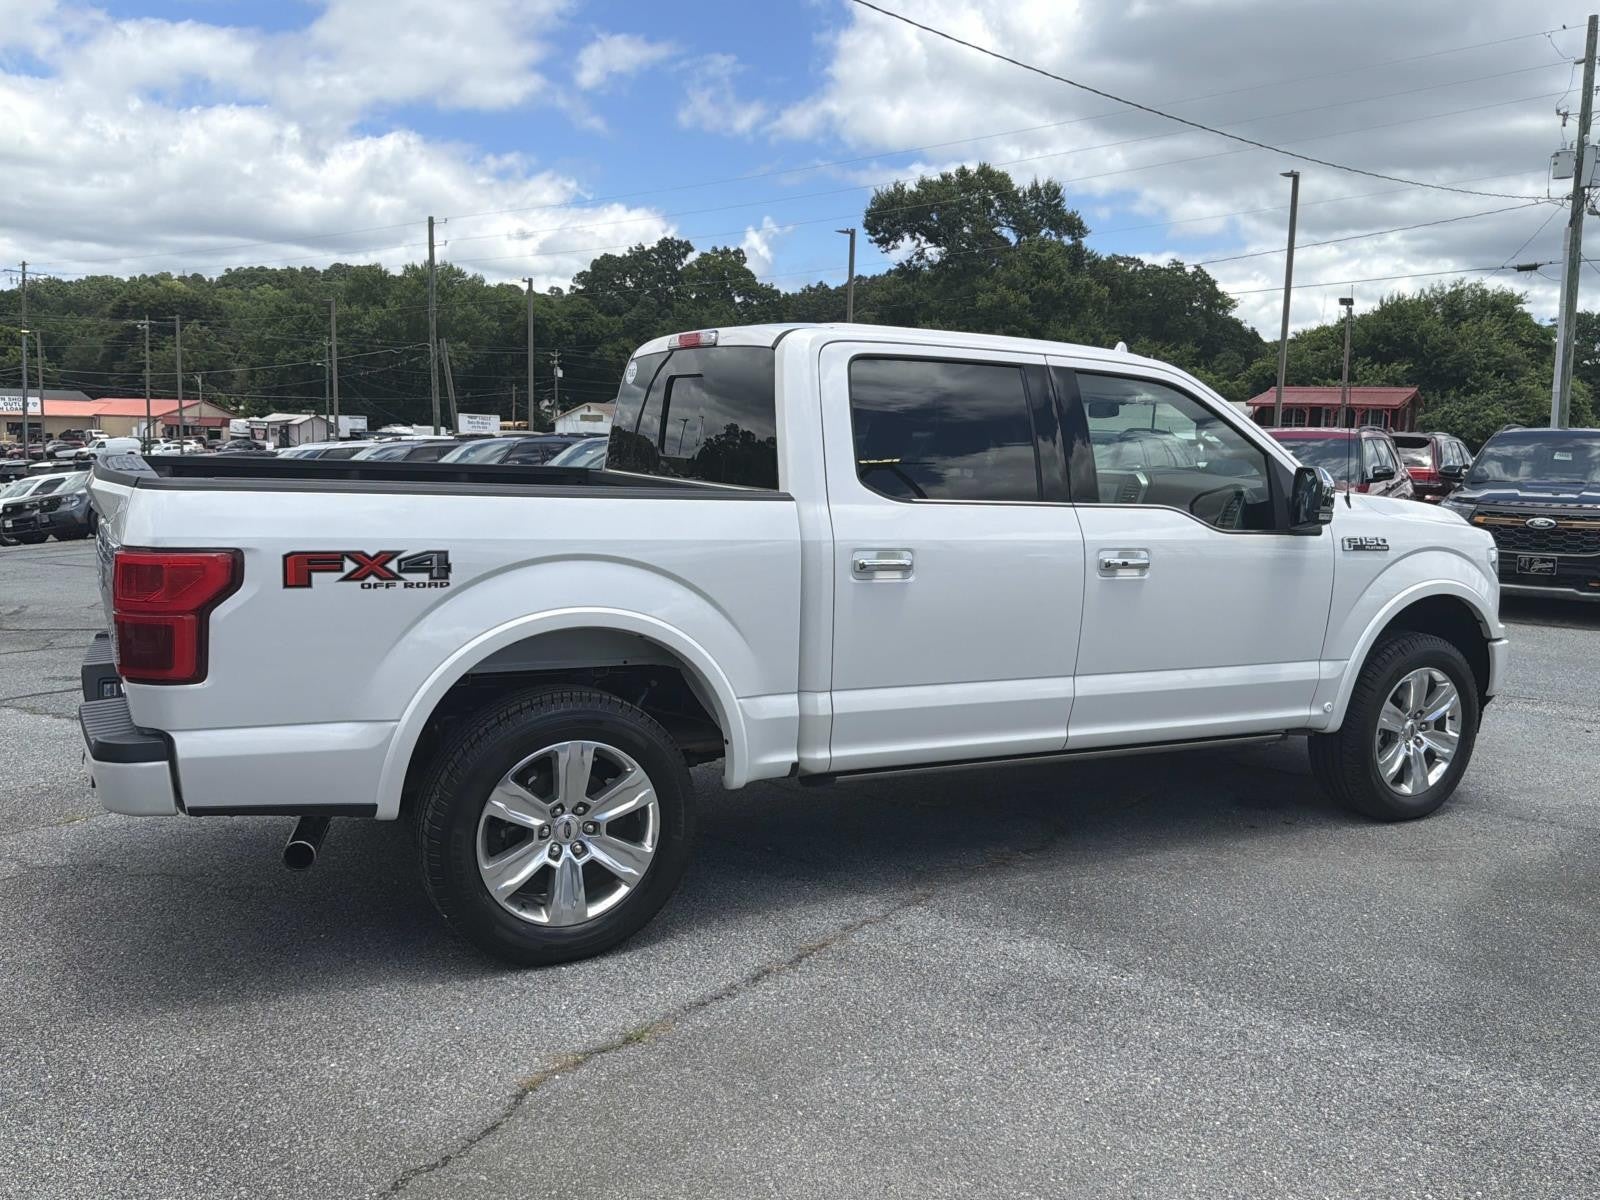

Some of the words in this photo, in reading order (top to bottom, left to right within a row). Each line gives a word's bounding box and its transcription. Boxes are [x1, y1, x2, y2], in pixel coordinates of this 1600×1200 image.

[282, 550, 452, 588] FX4
[361, 582, 397, 590] OFF
[404, 581, 450, 589] ROAD
